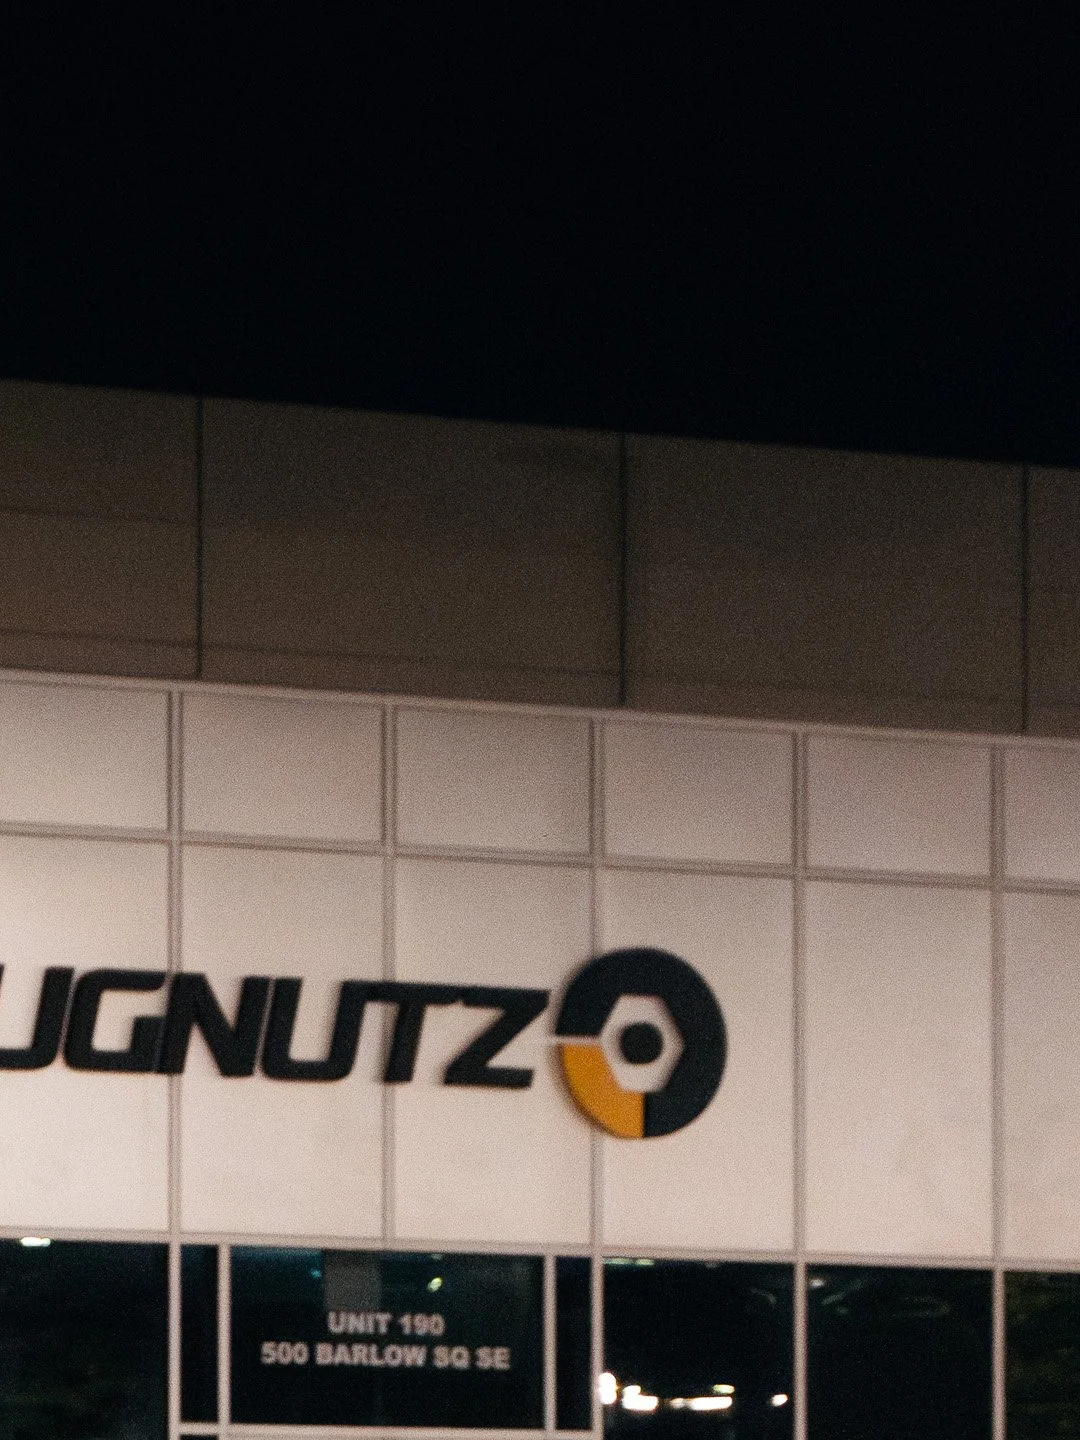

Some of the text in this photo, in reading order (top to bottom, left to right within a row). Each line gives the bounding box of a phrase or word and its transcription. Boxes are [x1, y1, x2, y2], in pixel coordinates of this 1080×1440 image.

[327, 1311, 446, 1337] UNIT 190
[260, 1341, 512, 1371] 500 BARLOW SQ SE
